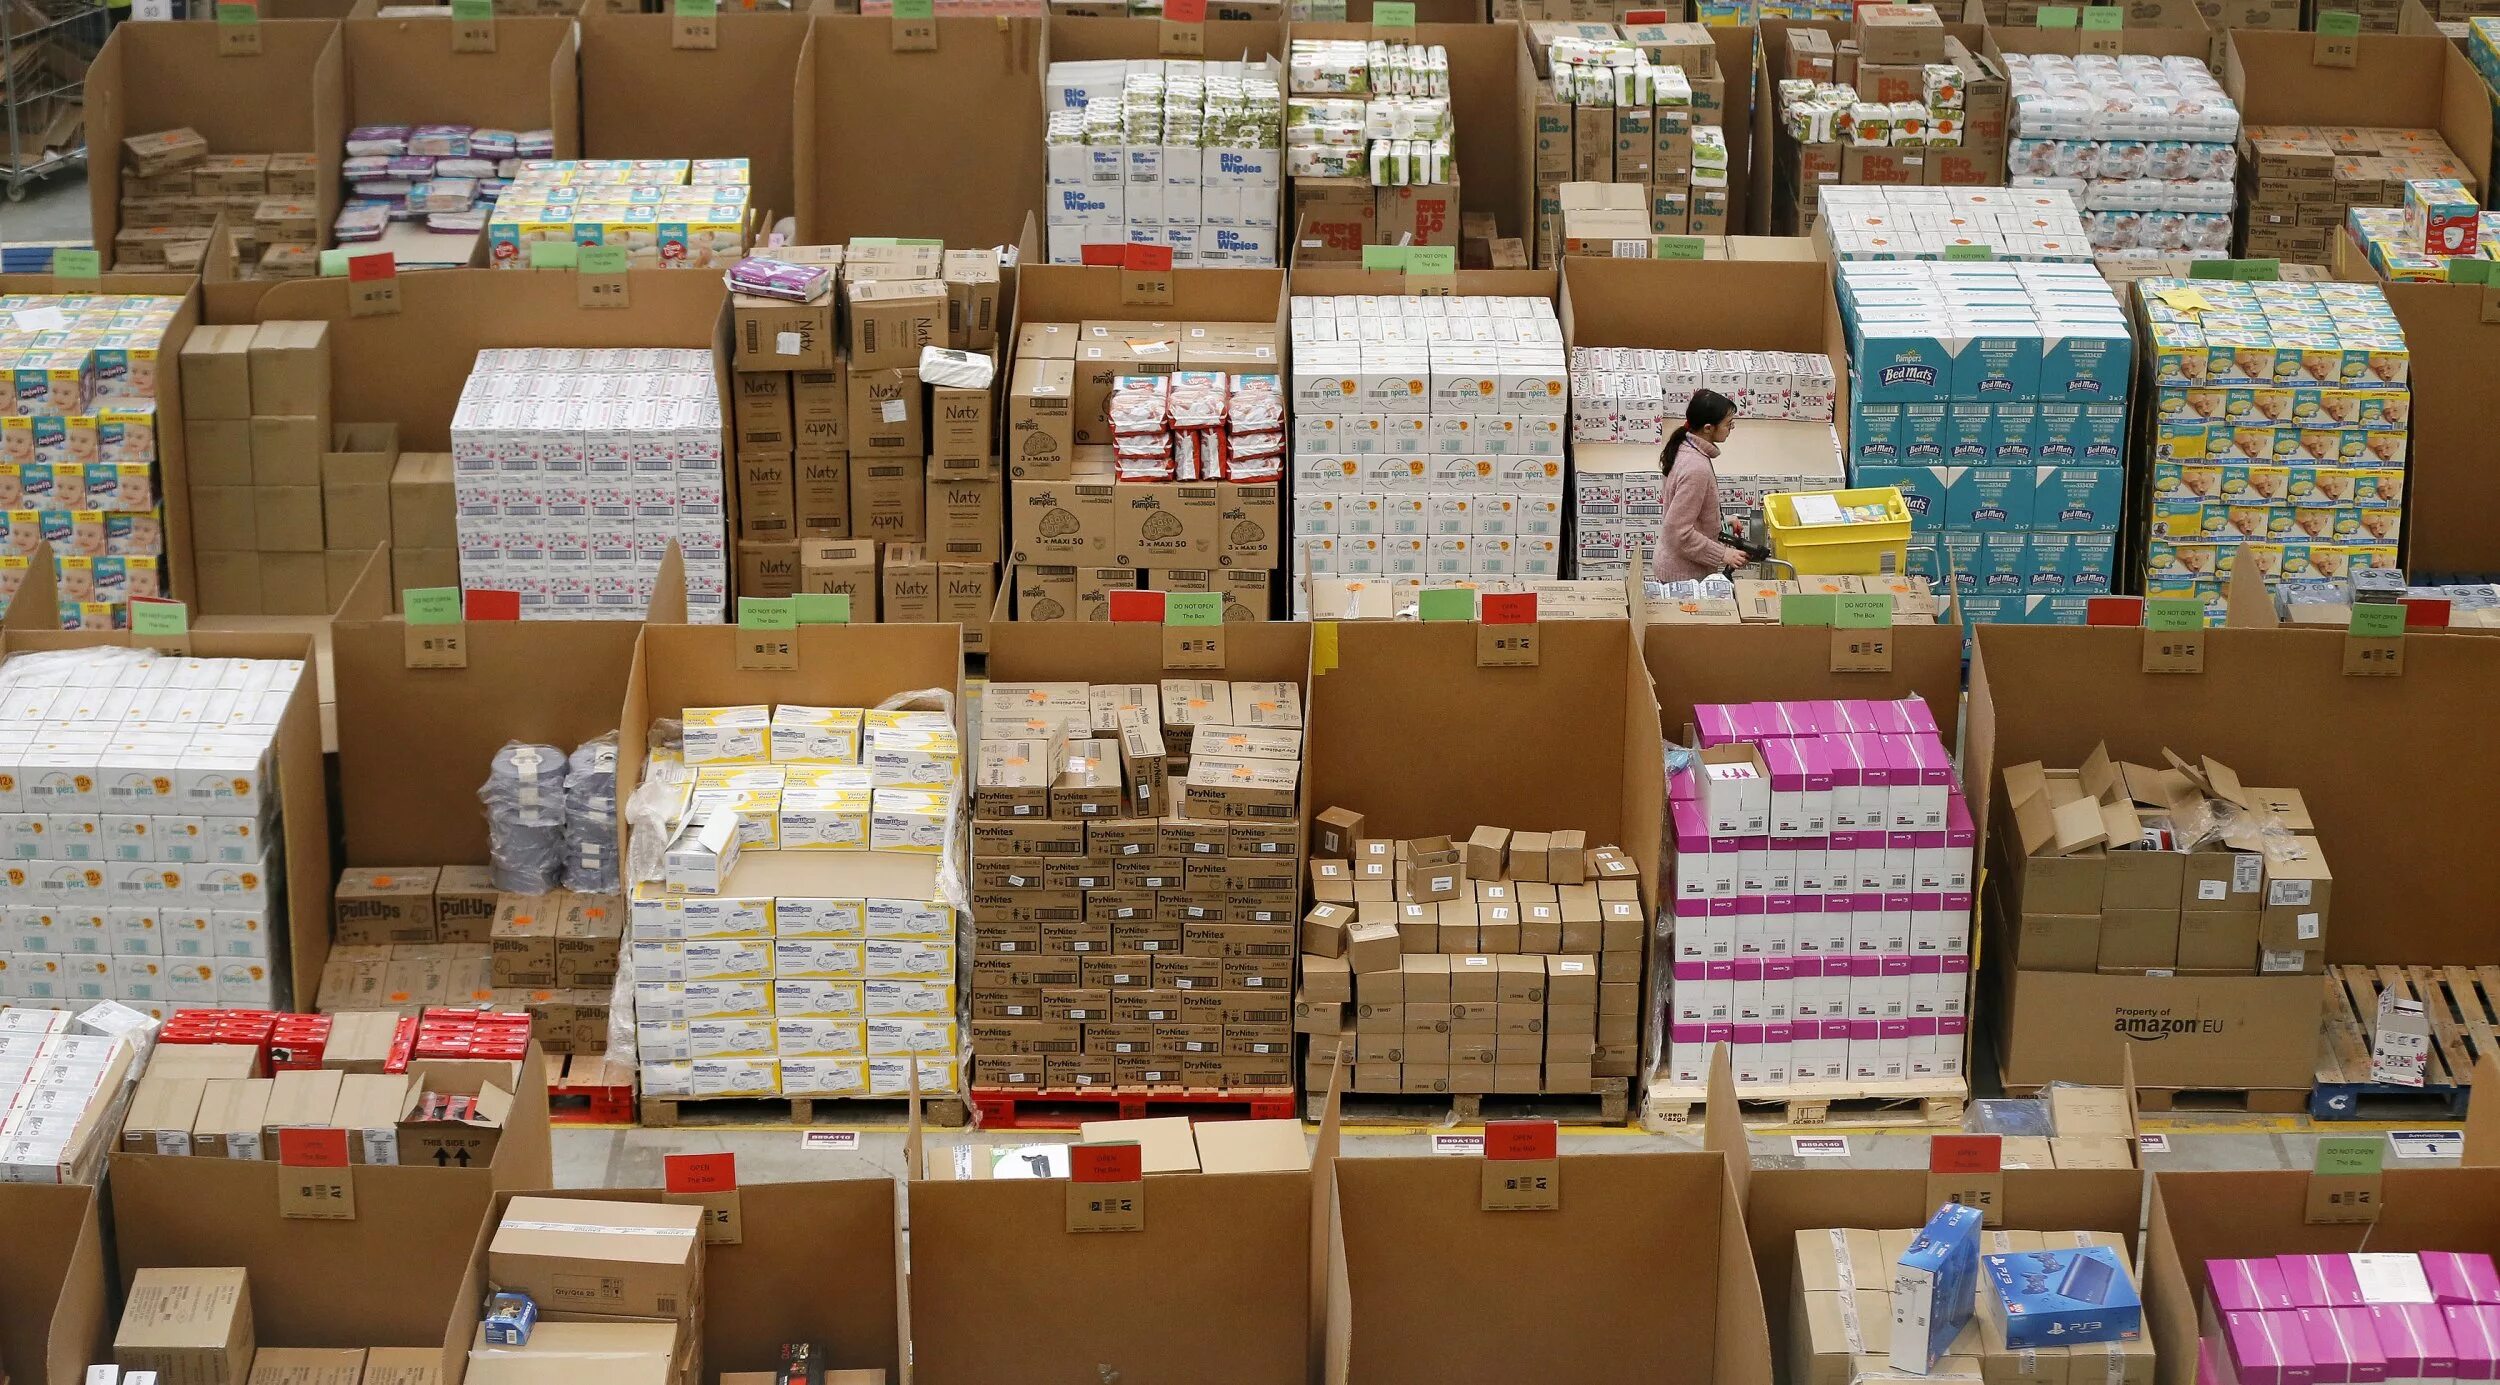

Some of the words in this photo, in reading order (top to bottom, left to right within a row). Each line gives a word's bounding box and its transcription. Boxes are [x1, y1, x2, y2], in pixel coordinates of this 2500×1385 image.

[1620, 117, 1640, 125] Bio
[1620, 123, 1650, 134] Baby
[1220, 154, 1242, 164] Bio
[1940, 157, 1974, 170] Bio
[1220, 163, 1262, 175] Wipes
[1940, 168, 1988, 184] Baby
[1064, 190, 1086, 200] Bio
[1064, 200, 1106, 212] Wipes
[1216, 230, 1238, 240] Bio
[1217, 240, 1258, 252] Wipes
[800, 320, 814, 350] Naty
[1896, 352, 1922, 363] Pampers
[1885, 367, 1904, 380] Bed
[1906, 367, 1932, 381] Mats
[2069, 381, 2082, 390] Bed
[2082, 382, 2100, 391] Mats
[1015, 422, 1039, 431] Pampers
[1029, 496, 1058, 506] Pampers
[1132, 500, 1160, 510] Pampers
[1222, 512, 1246, 520] Pampers
[1072, 537, 1084, 545] 50
[447, 640, 456, 650] A1
[779, 644, 788, 654] A1
[1206, 640, 1215, 652] A1
[1520, 638, 1530, 649] A1
[1874, 643, 1883, 654] A1
[2186, 644, 2195, 656] A1
[2386, 650, 2395, 660] A1
[980, 792, 1013, 800] DryNites
[1187, 789, 1225, 798] DryNites
[1188, 864, 1226, 874] DryNites
[2116, 1007, 2154, 1018] Property
[2159, 1008, 2171, 1016] of
[2114, 1018, 2197, 1034] amazon
[2202, 1020, 2224, 1032] EU
[1156, 1028, 1189, 1036] DryNites
[1536, 1177, 1546, 1190] A1
[330, 1186, 341, 1198] A1
[2360, 1192, 2370, 1203] A1
[1980, 1192, 1991, 1204] A1
[1121, 1200, 1132, 1211] A1
[717, 1210, 728, 1223] A1
[1949, 1214, 1962, 1227] PS3
[1998, 1266, 2012, 1284] PS3
[2070, 1322, 2102, 1331] PS3
